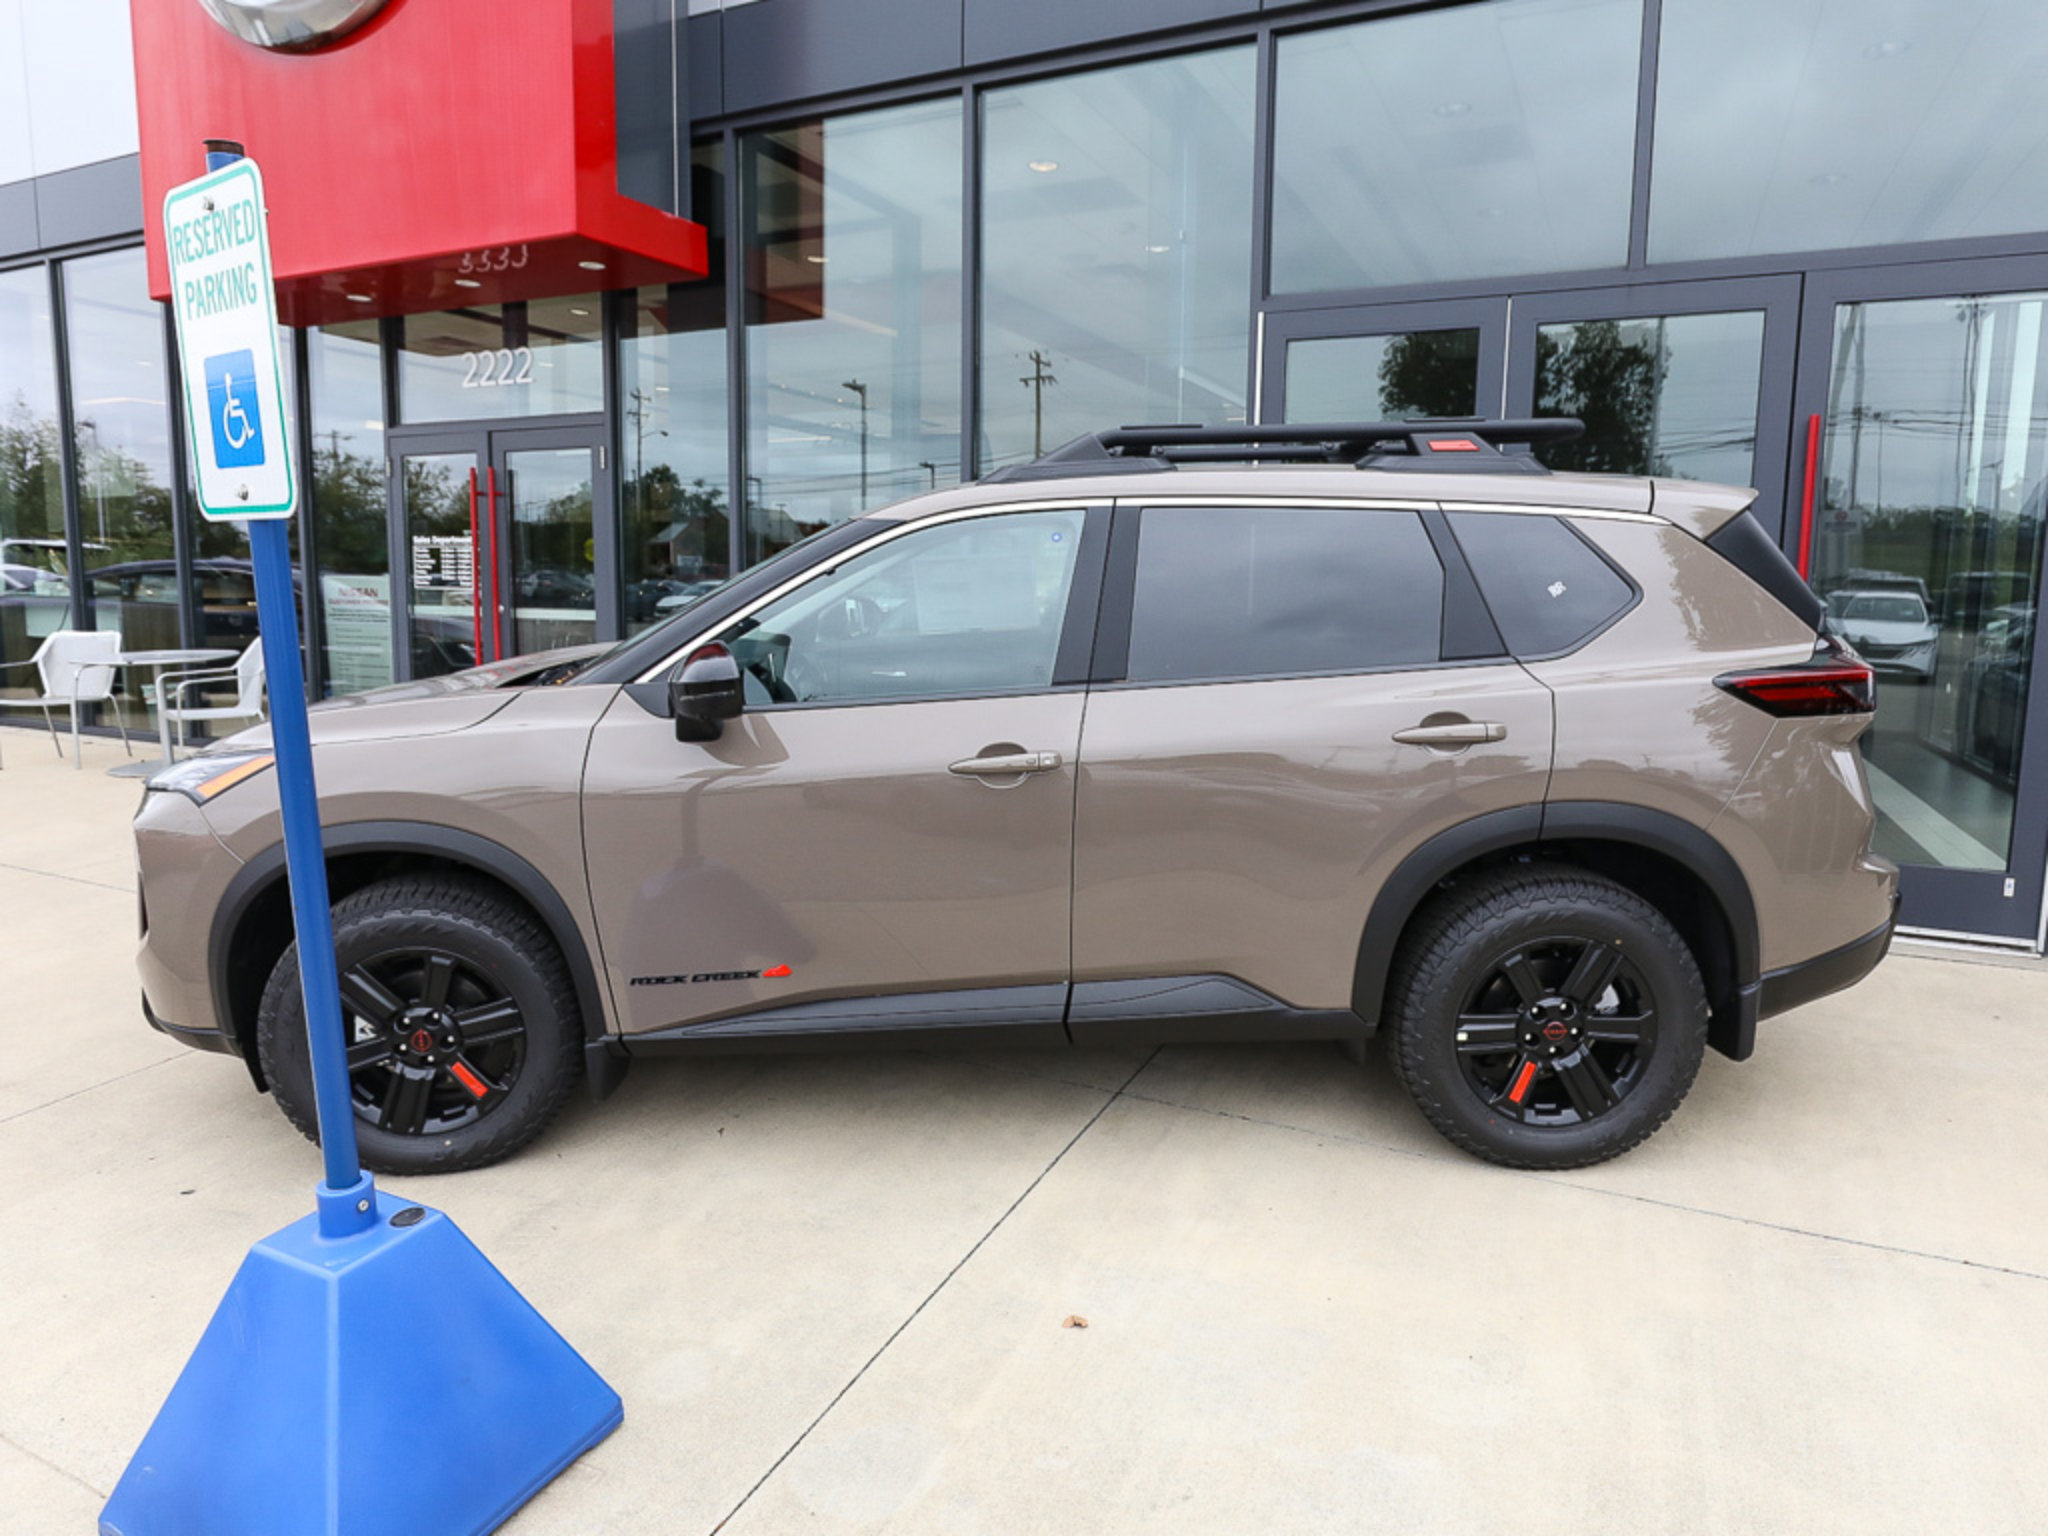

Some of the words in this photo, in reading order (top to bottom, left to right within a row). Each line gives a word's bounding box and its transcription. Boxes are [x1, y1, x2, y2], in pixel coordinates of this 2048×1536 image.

[173, 200, 255, 265] RESERVED
[184, 262, 257, 320] PARKING
[462, 346, 533, 388] 2222
[629, 974, 688, 986] ROCK
[691, 970, 762, 983] CREEK
